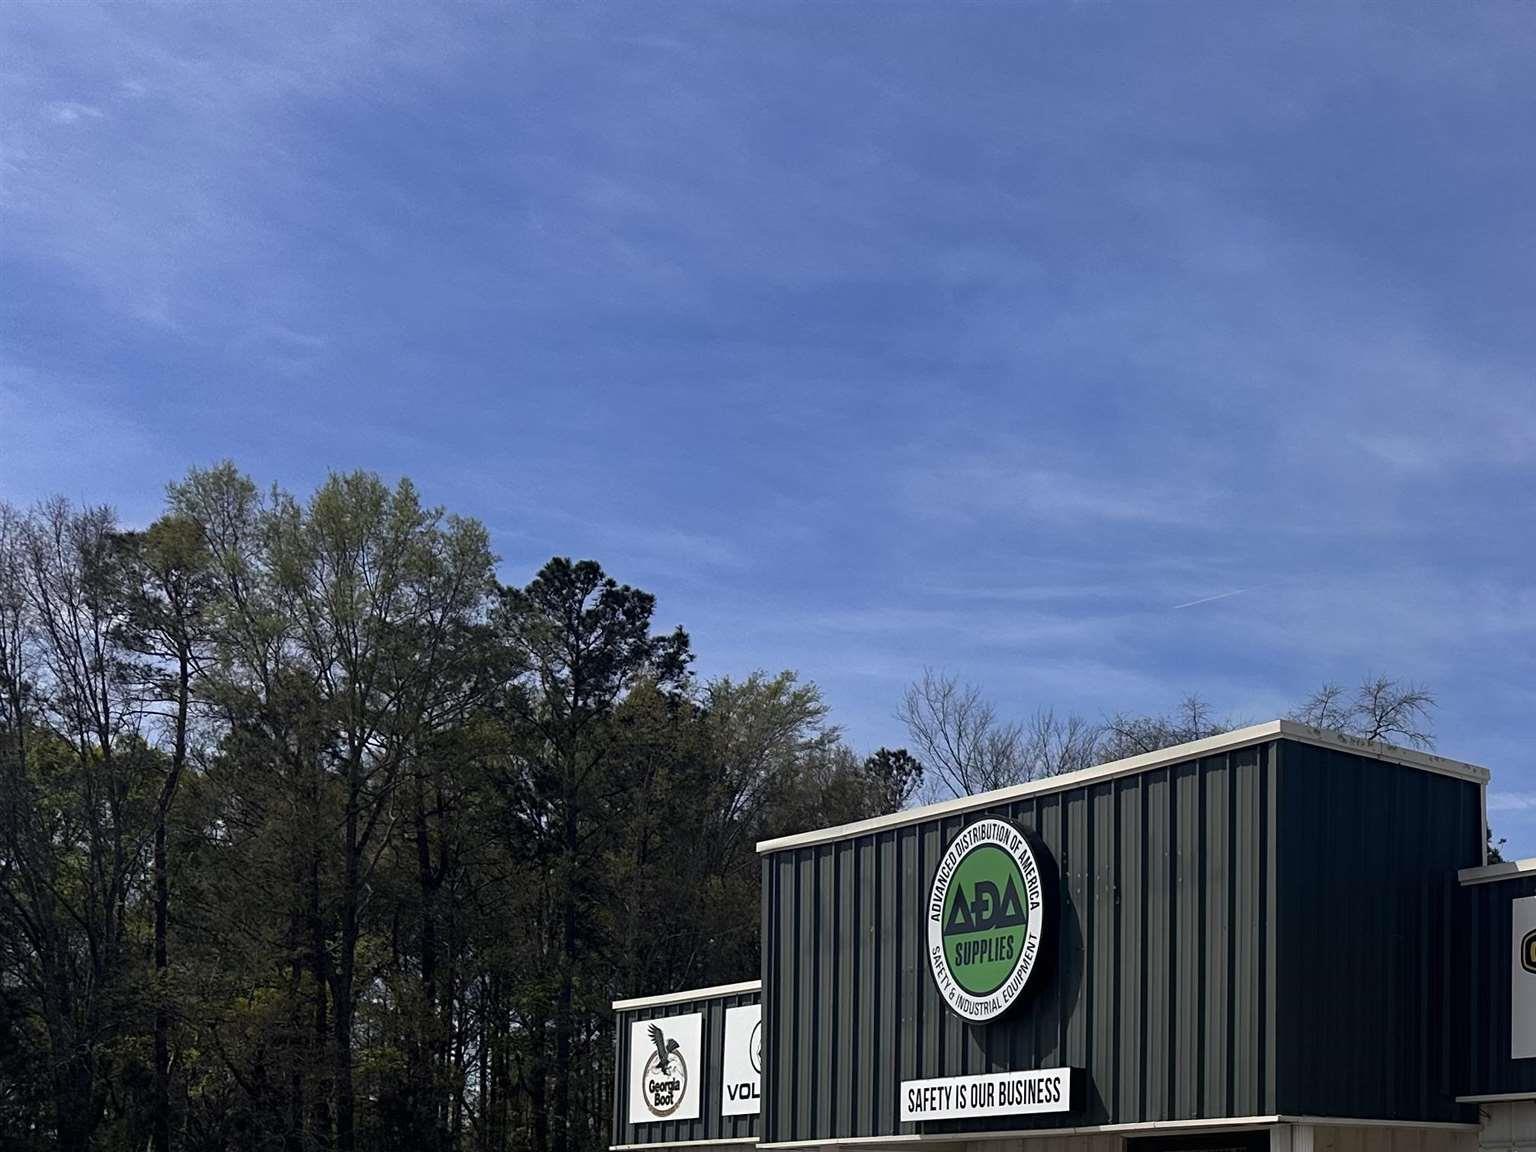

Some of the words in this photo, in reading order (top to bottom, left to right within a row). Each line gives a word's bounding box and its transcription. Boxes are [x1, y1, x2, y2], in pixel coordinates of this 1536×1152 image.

[931, 854, 957, 922] ADVANCED
[956, 823, 1010, 856] DISTRIBUTION
[1009, 835, 1023, 851] OF
[1018, 849, 1040, 910] AMERICA
[944, 873, 1027, 935] ADA
[955, 935, 1014, 966] SUPPLIES
[932, 946, 952, 992] SAFETY
[955, 996, 1003, 1016] INDUSTRIAL
[1002, 934, 1038, 1004] EQUIPMENT
[649, 1077, 680, 1094] Georgia
[654, 1091, 674, 1107] Boot
[908, 1086, 952, 1113] SAFETY
[955, 1084, 967, 1110] IS
[970, 1083, 995, 1108] OUR
[999, 1077, 1061, 1107] BUSINESS
